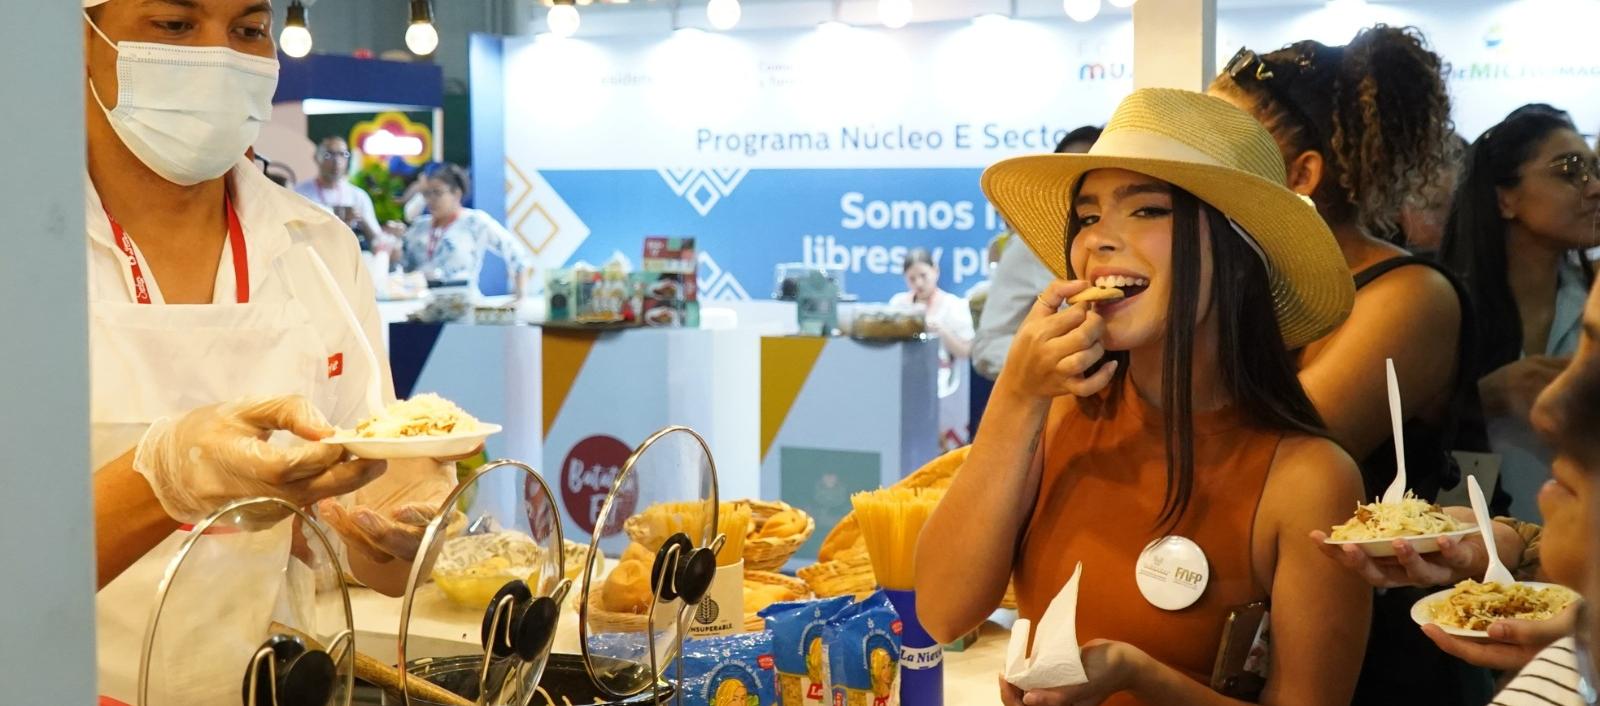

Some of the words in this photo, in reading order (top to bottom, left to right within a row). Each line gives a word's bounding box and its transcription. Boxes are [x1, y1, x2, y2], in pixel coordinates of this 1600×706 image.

[697, 127, 830, 157] Programa
[841, 122, 943, 149] Núcleo
[955, 123, 971, 148] E
[983, 122, 1070, 149] Secto
[840, 192, 976, 230] Somos
[803, 234, 906, 274] libres
[690, 623, 733, 633] NSUPERABLE
